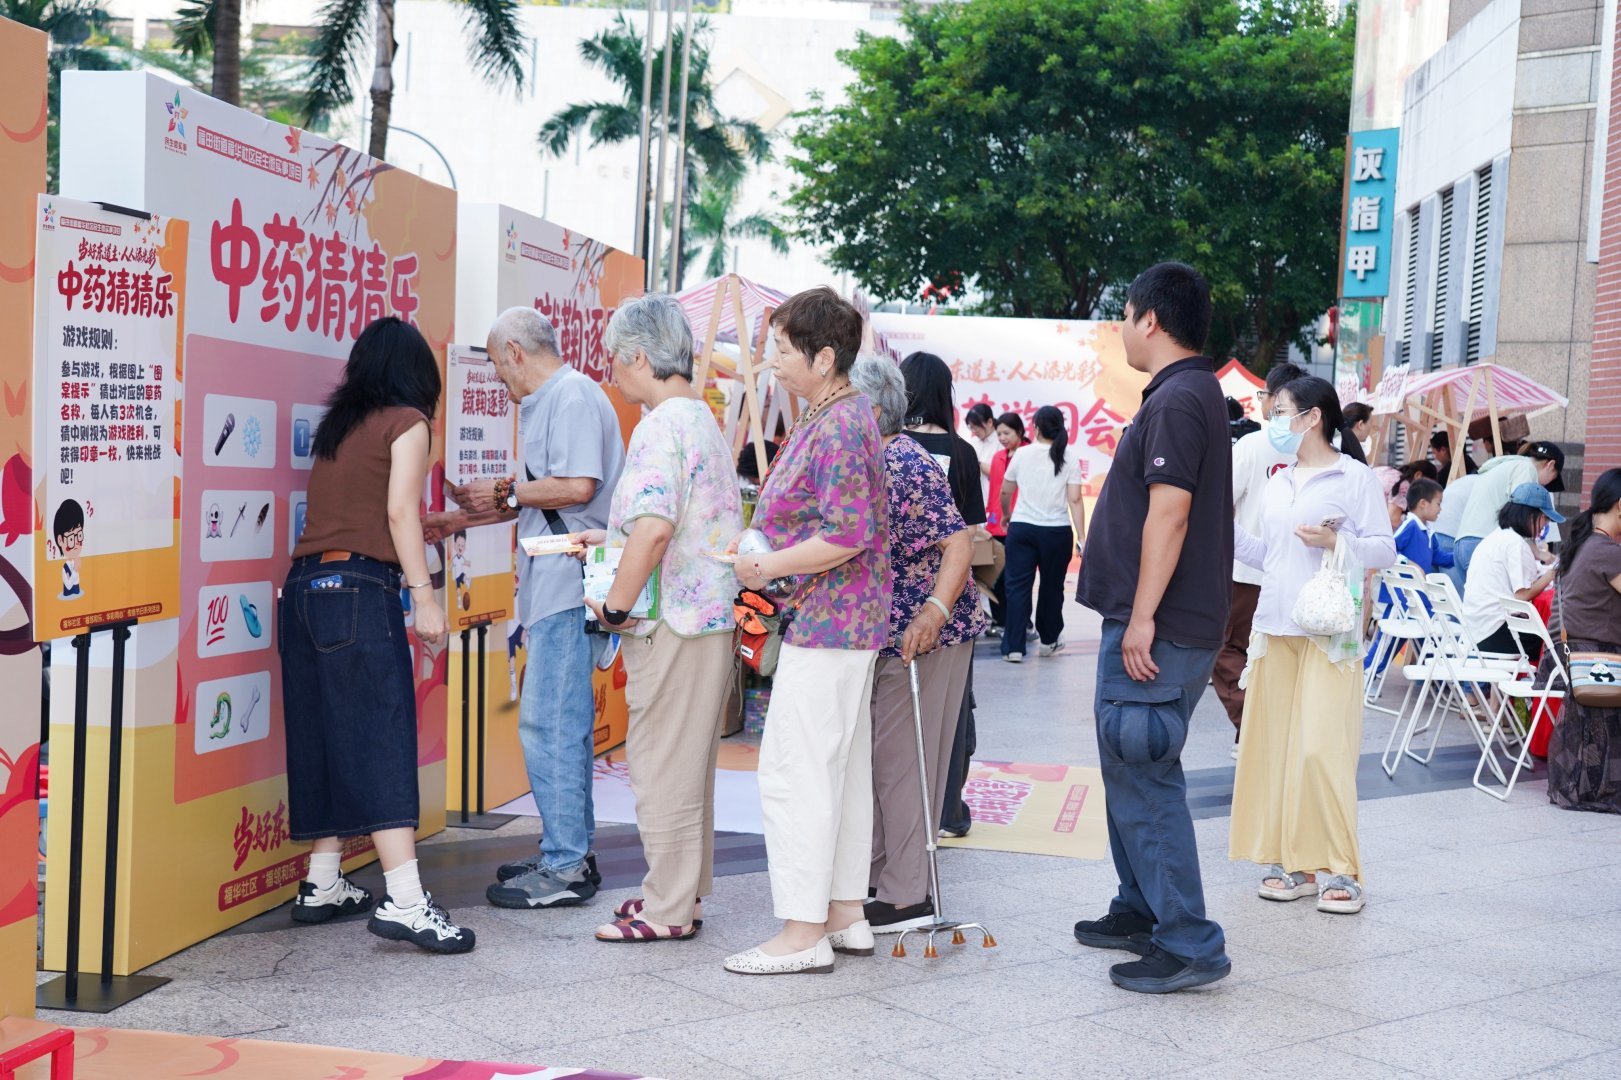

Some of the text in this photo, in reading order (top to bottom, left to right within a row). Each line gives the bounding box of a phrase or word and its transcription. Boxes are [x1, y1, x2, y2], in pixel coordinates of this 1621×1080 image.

[1347, 147, 1385, 281] 灰指甲
[58, 260, 174, 318] 中药猜猜乐
[534, 291, 615, 384] 蹴鞠逐
[462, 387, 509, 417] 蹴鞠逐影
[60, 445, 162, 463] 获得印章一枚，快来挑战
[233, 799, 290, 871] 当好东
